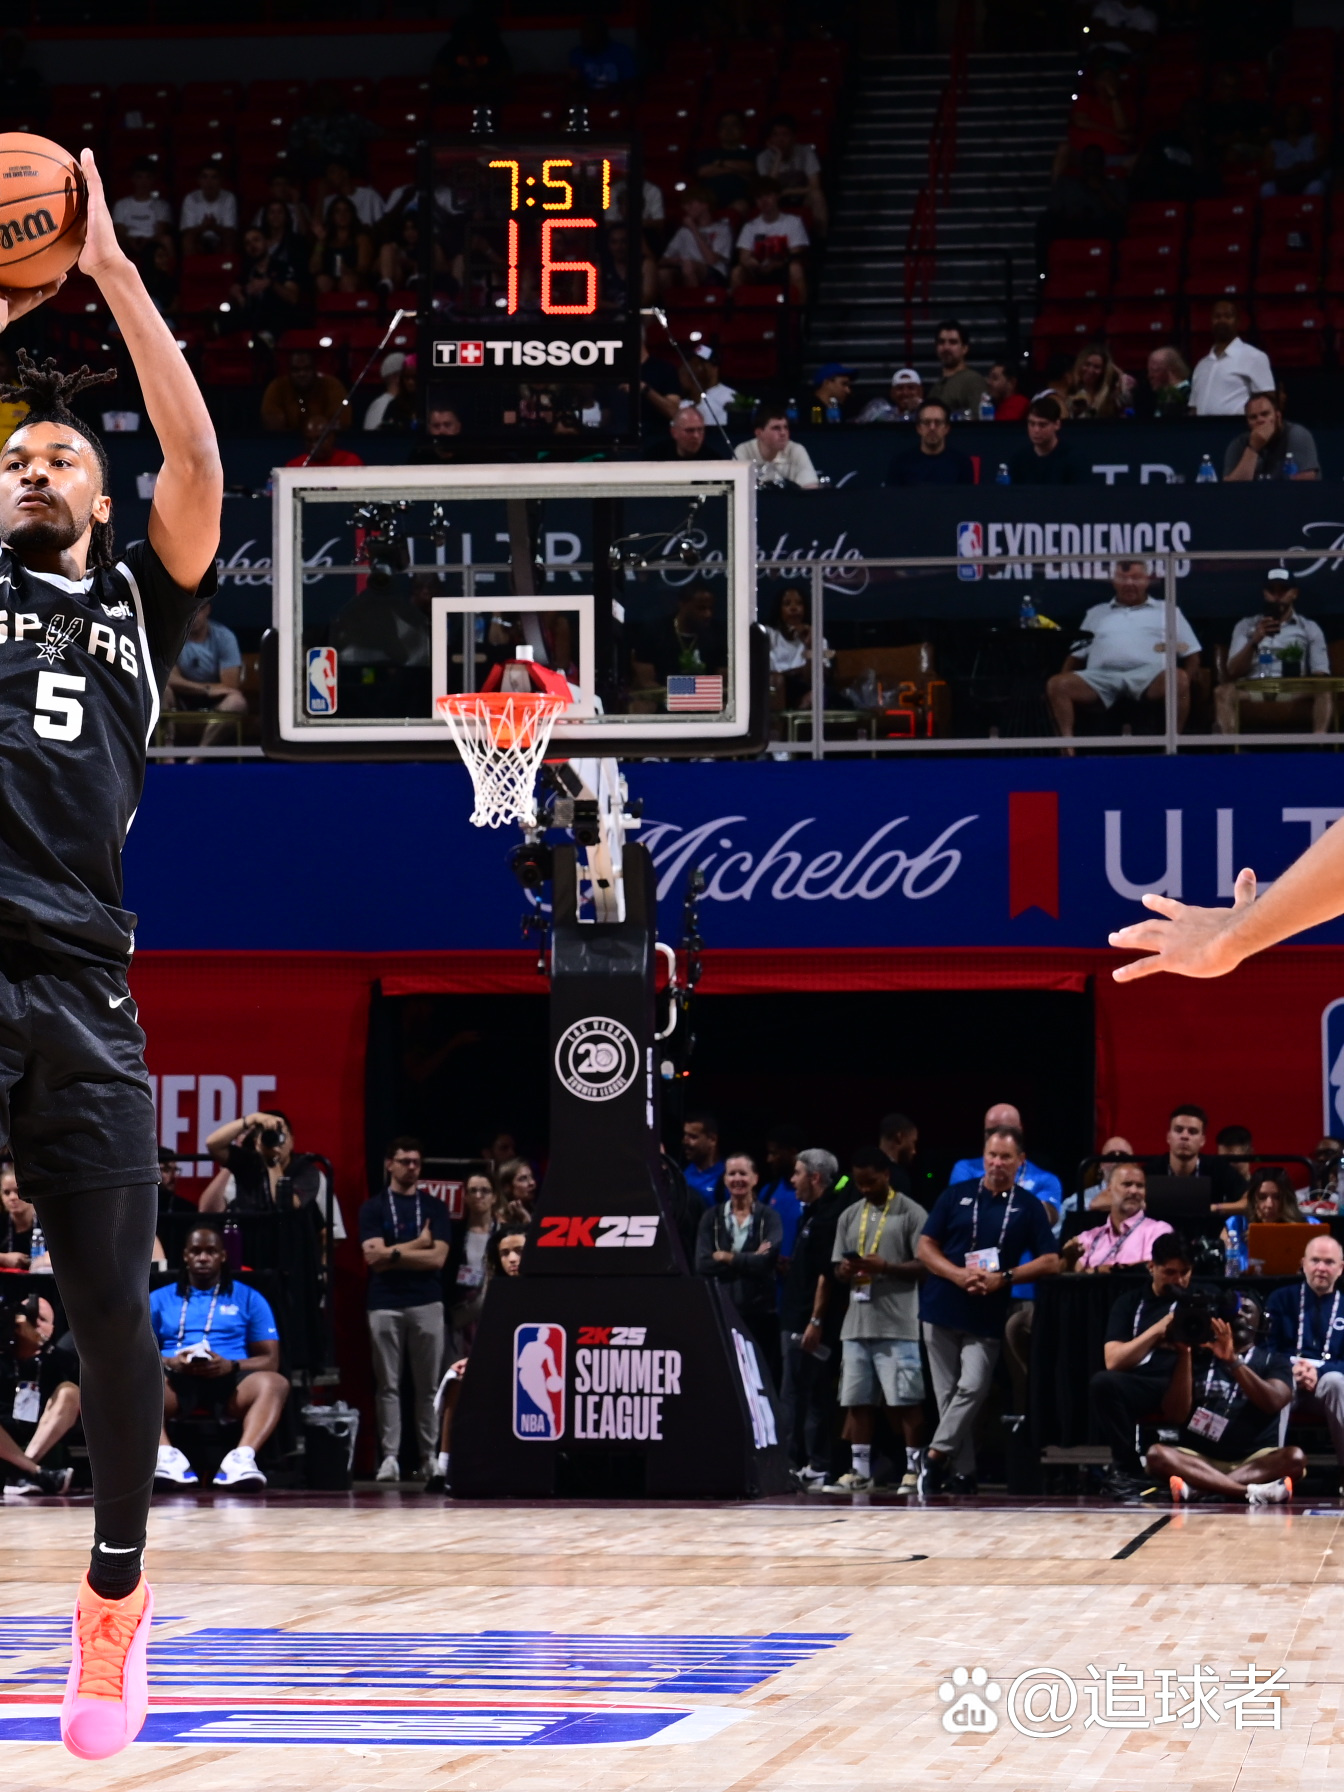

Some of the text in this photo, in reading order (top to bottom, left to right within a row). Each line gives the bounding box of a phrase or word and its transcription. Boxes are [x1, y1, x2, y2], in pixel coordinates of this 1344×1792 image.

[489, 159, 610, 211] 7:51
[508, 219, 597, 315] 16
[485, 340, 623, 366] TISSOT
[987, 521, 1191, 580] EXPERIENCES
[33, 670, 87, 742] 5
[640, 807, 1344, 902] Michelob ULT
[566, 1021, 628, 1043] LAS VEGAS
[577, 1042, 620, 1073] 20
[147, 1074, 277, 1178] ER
[417, 1184, 460, 1213] IT
[537, 1215, 660, 1248] 2K25
[576, 1326, 647, 1346] 2K25
[574, 1348, 682, 1394] SUMMER
[520, 1413, 545, 1433] NBA
[574, 1394, 663, 1441] LEAGUE
